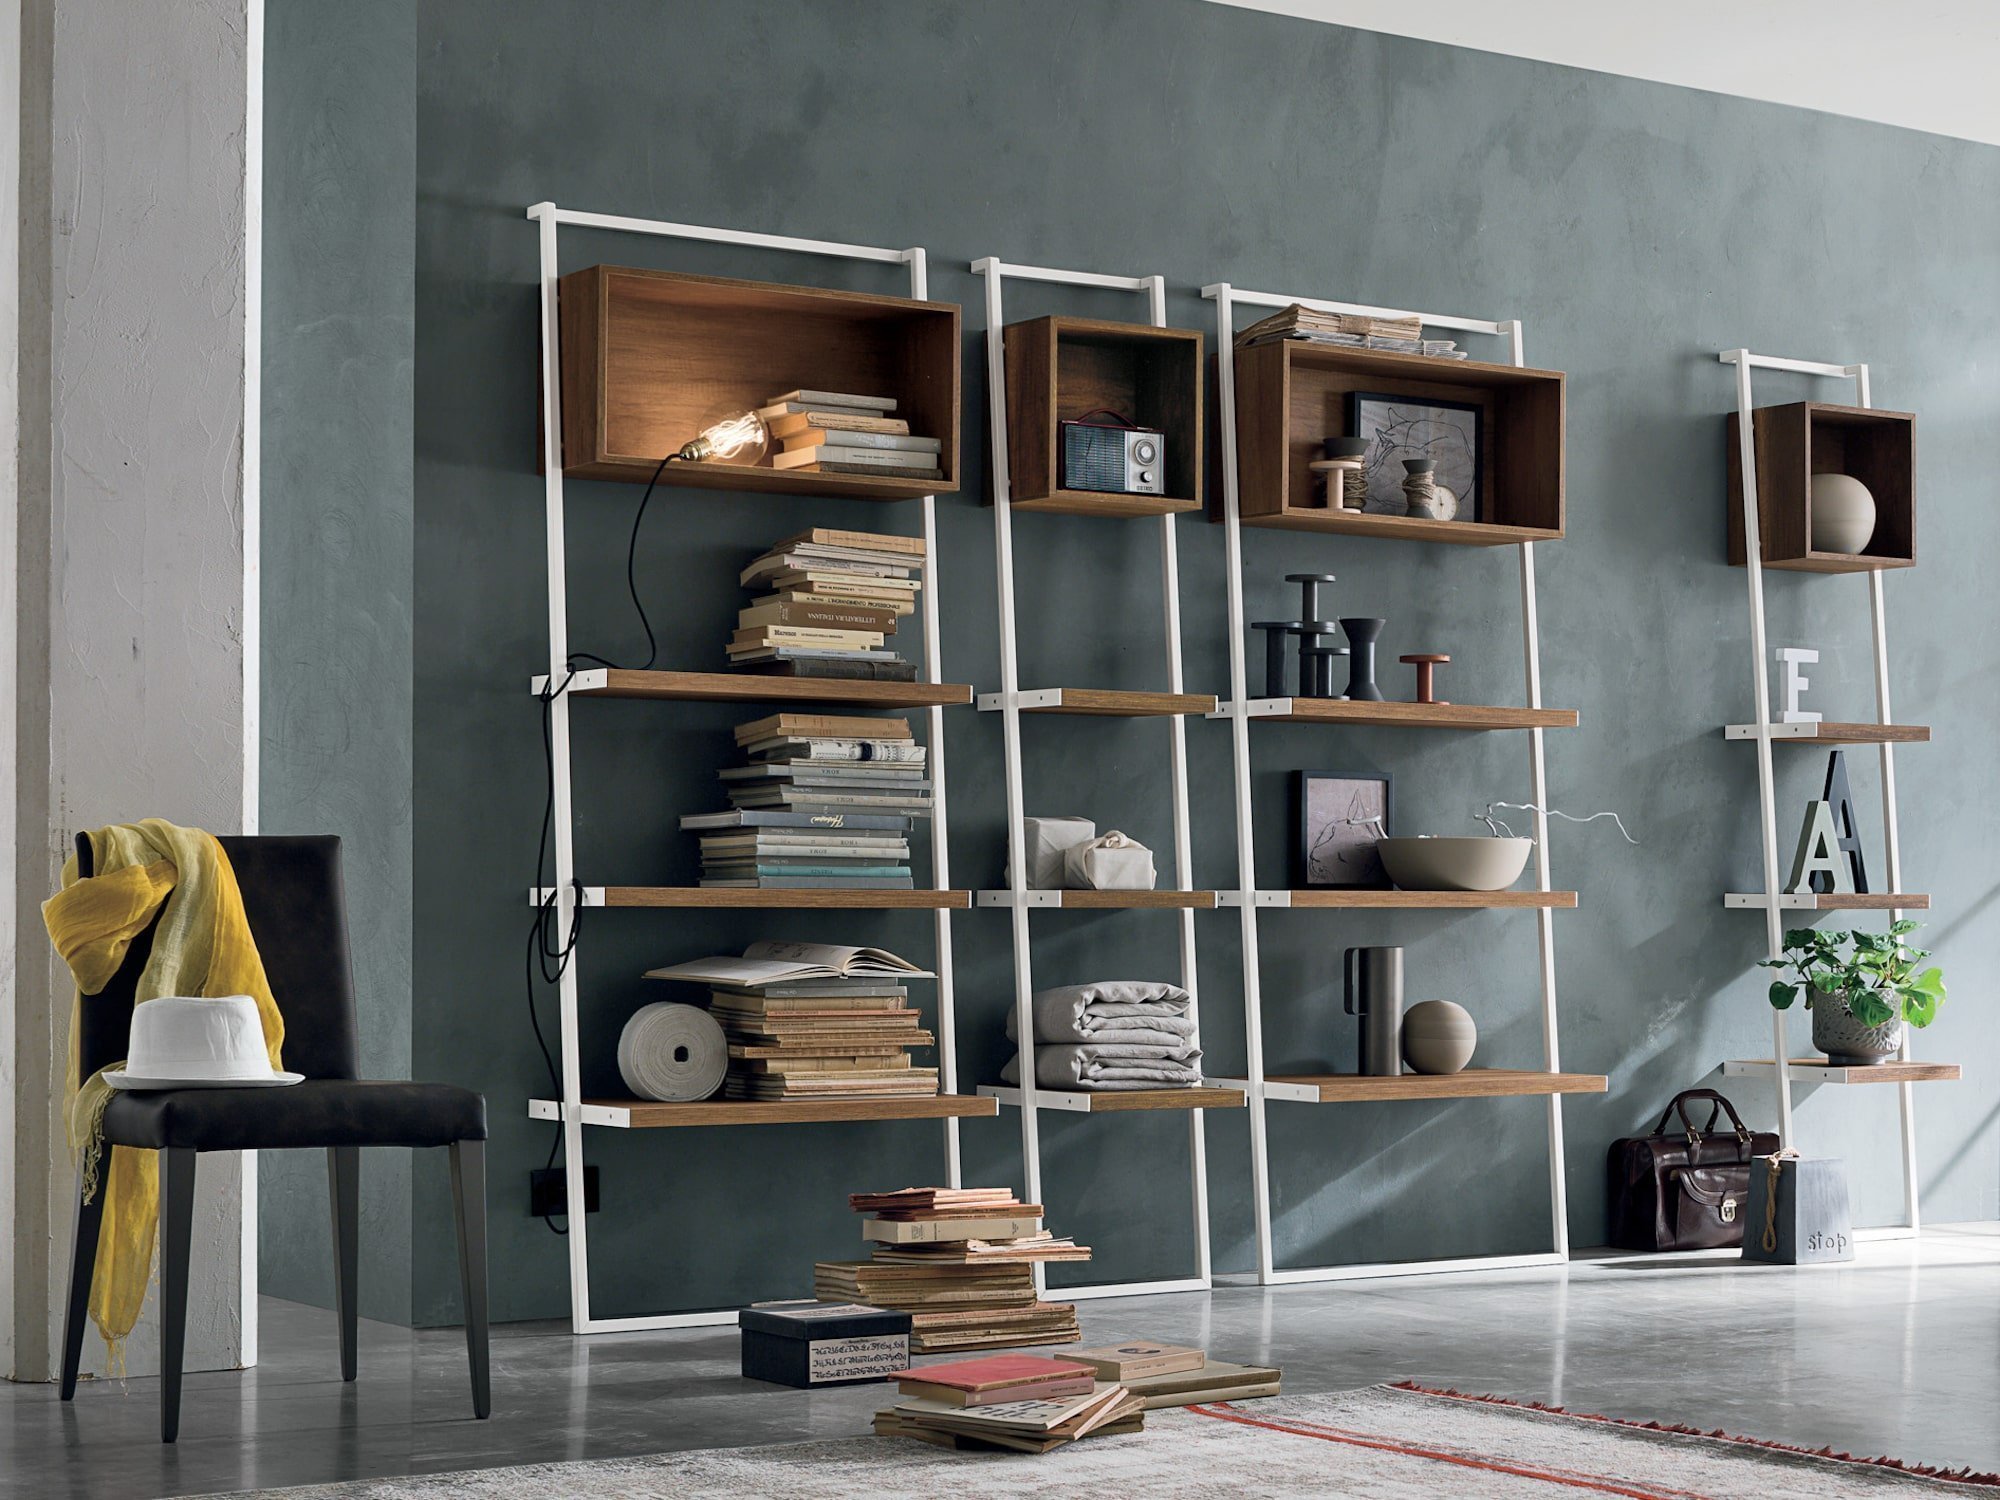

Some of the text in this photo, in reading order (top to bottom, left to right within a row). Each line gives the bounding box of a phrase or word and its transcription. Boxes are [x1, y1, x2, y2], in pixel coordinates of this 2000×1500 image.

[1776, 648, 1822, 723] E
[1784, 800, 1856, 893] A
[1823, 751, 1869, 893] A
[1808, 1230, 1847, 1254] stop
